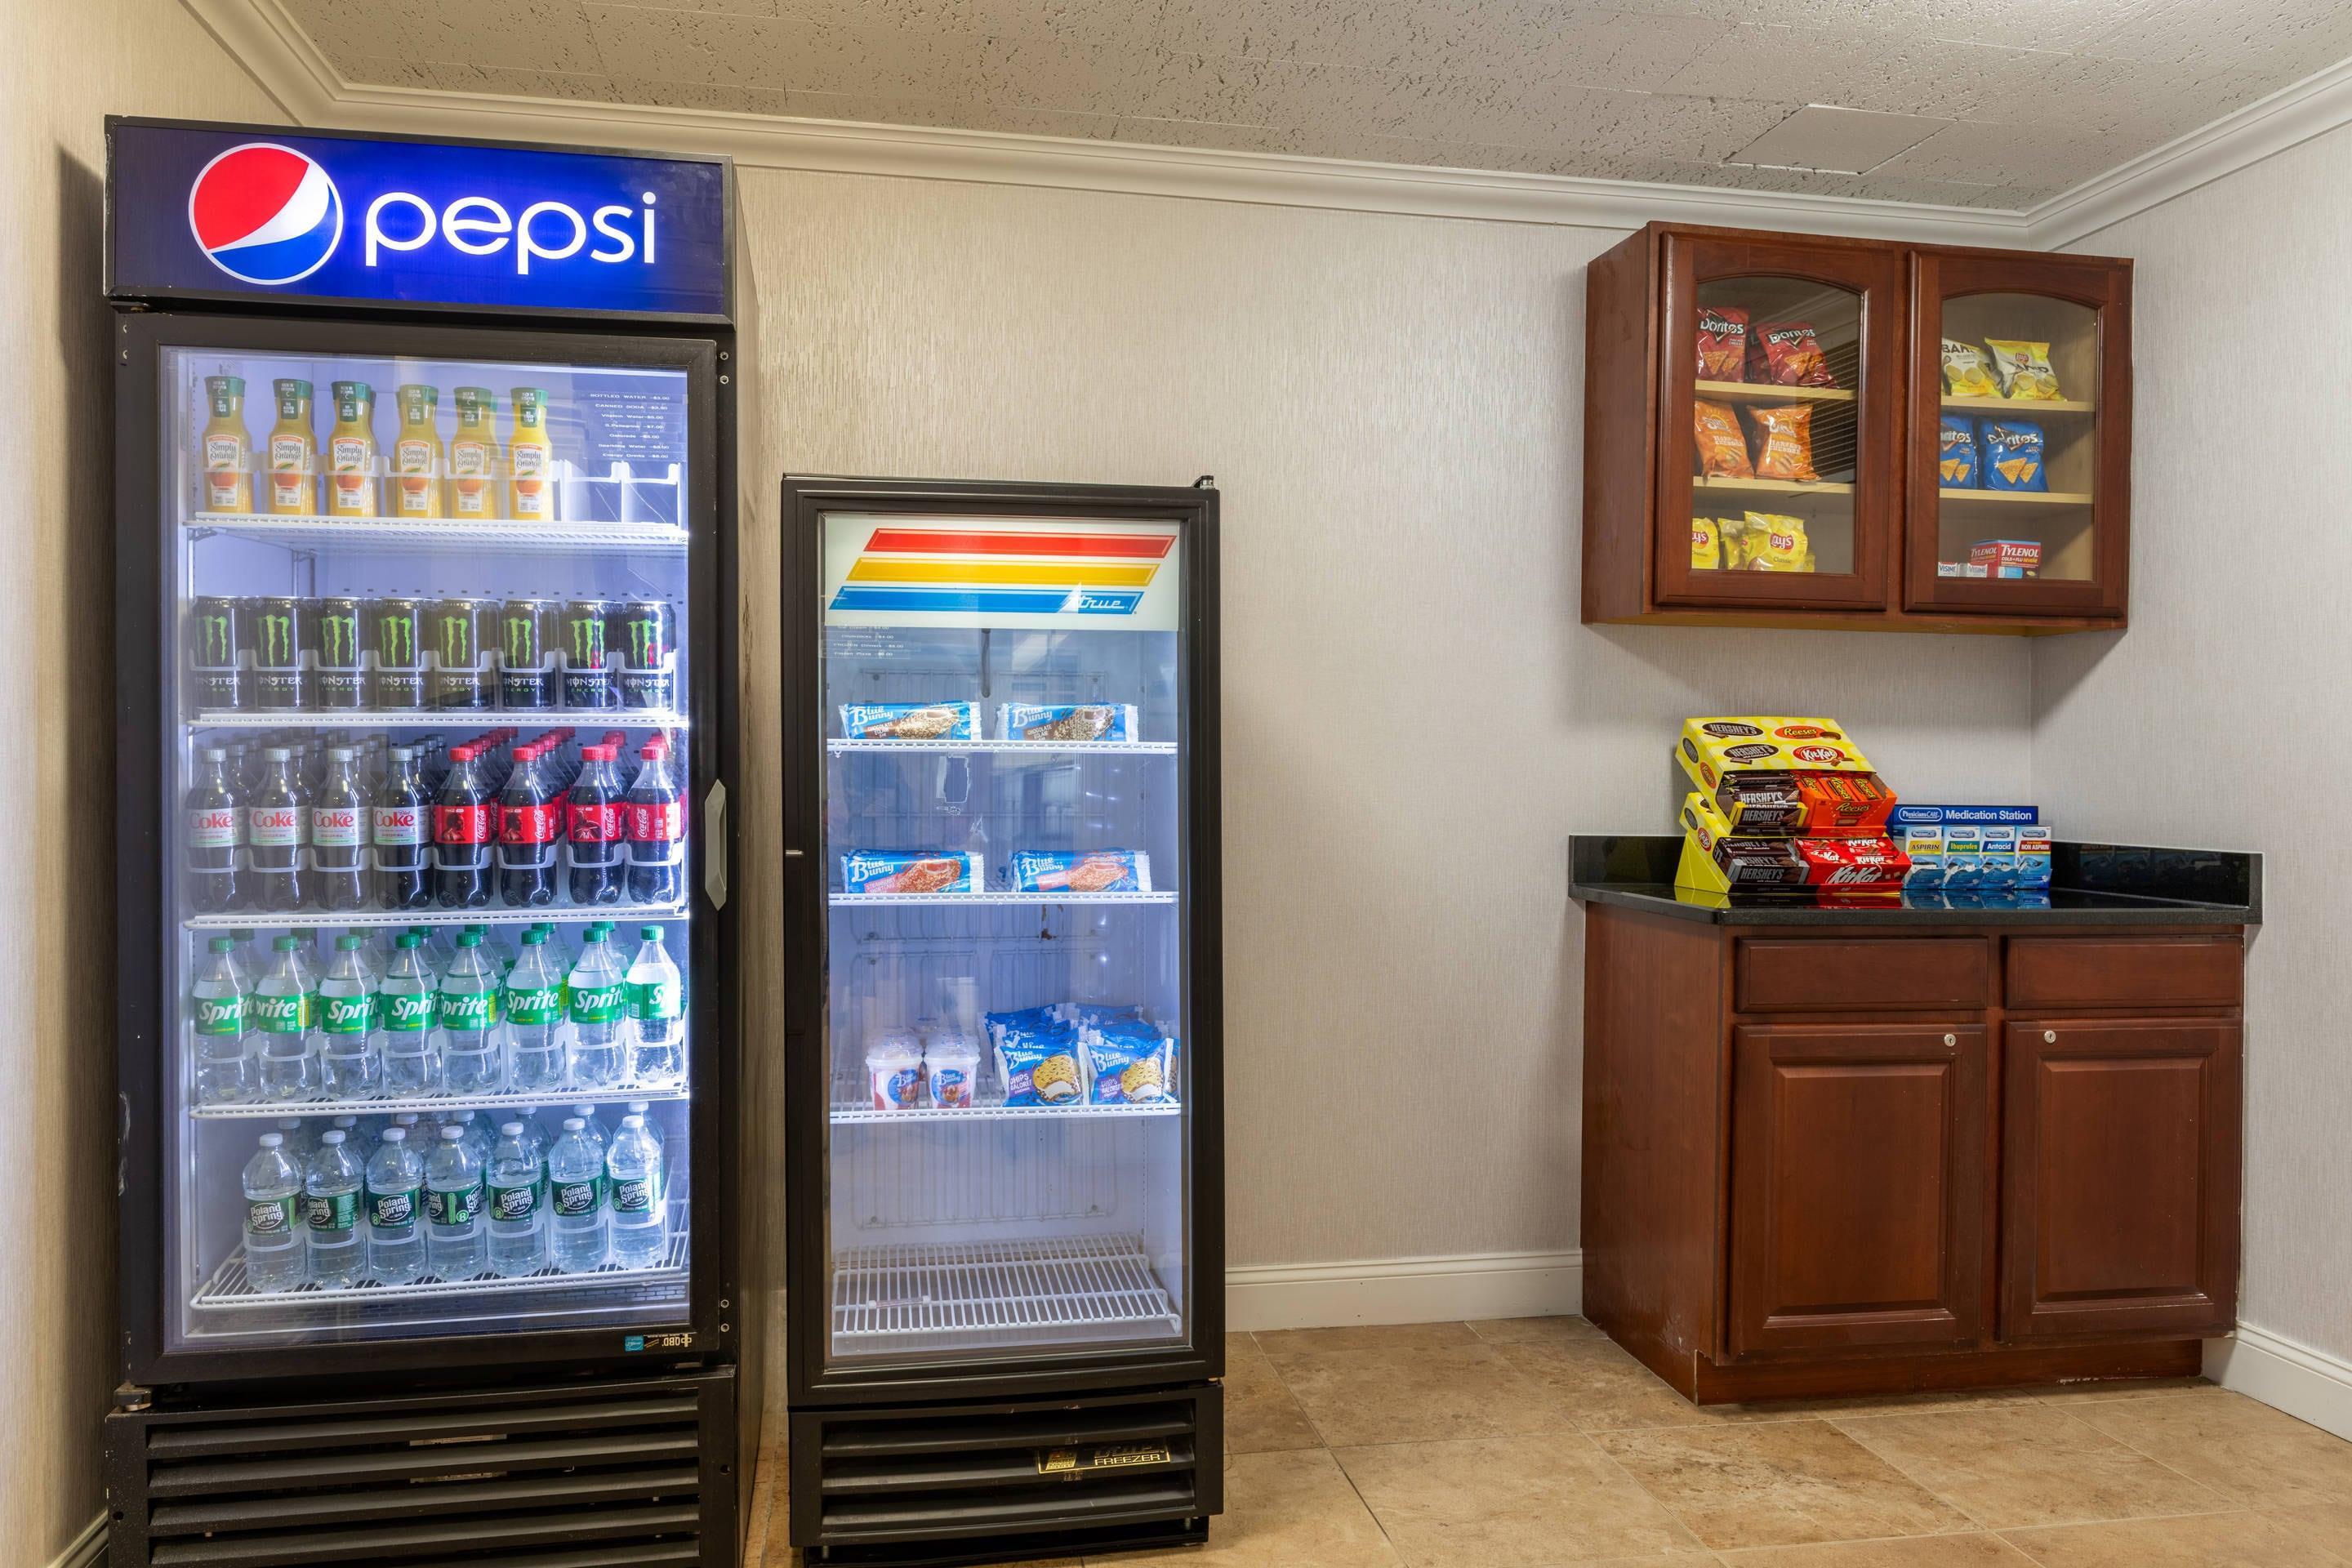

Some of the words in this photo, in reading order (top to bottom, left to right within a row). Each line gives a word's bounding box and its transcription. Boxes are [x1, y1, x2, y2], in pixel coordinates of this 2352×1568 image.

[366, 192, 656, 275] pepsi
[1700, 318, 1744, 334] Doritos
[210, 442, 237, 452] Simply
[275, 442, 301, 453] Simply
[336, 445, 363, 456] Simply
[336, 453, 363, 464] Orange
[1971, 547, 1998, 557] TYLENOL
[2001, 545, 2039, 557] TYLENOL
[1710, 724, 1757, 735] HERSHEY'S
[1729, 745, 1775, 758] HERSHEY'S
[1740, 791, 1783, 804] HERSHEY'S
[190, 812, 234, 829] Coke
[253, 810, 296, 827] Coke
[313, 810, 354, 827] Coke
[374, 809, 415, 826] Coke
[1742, 810, 1784, 822] HERSHEY'S
[1946, 810, 1997, 820] Medication
[1999, 810, 2032, 820] Station
[1950, 843, 1977, 851] Ibuprofen
[1740, 868, 1784, 880] HERSHEY'S
[507, 990, 559, 1014] Sprite
[1009, 1073, 1029, 1085] CHIPS
[501, 1187, 532, 1203] Poland
[561, 1182, 591, 1198] Poland
[377, 1193, 409, 1209] Poland
[502, 1196, 533, 1213] Spring
[562, 1192, 592, 1208] Spring
[251, 1201, 282, 1217] Poland
[379, 1203, 412, 1218] Spring
[252, 1211, 284, 1226] Spring
[1094, 1453, 1161, 1466] FREEZER
